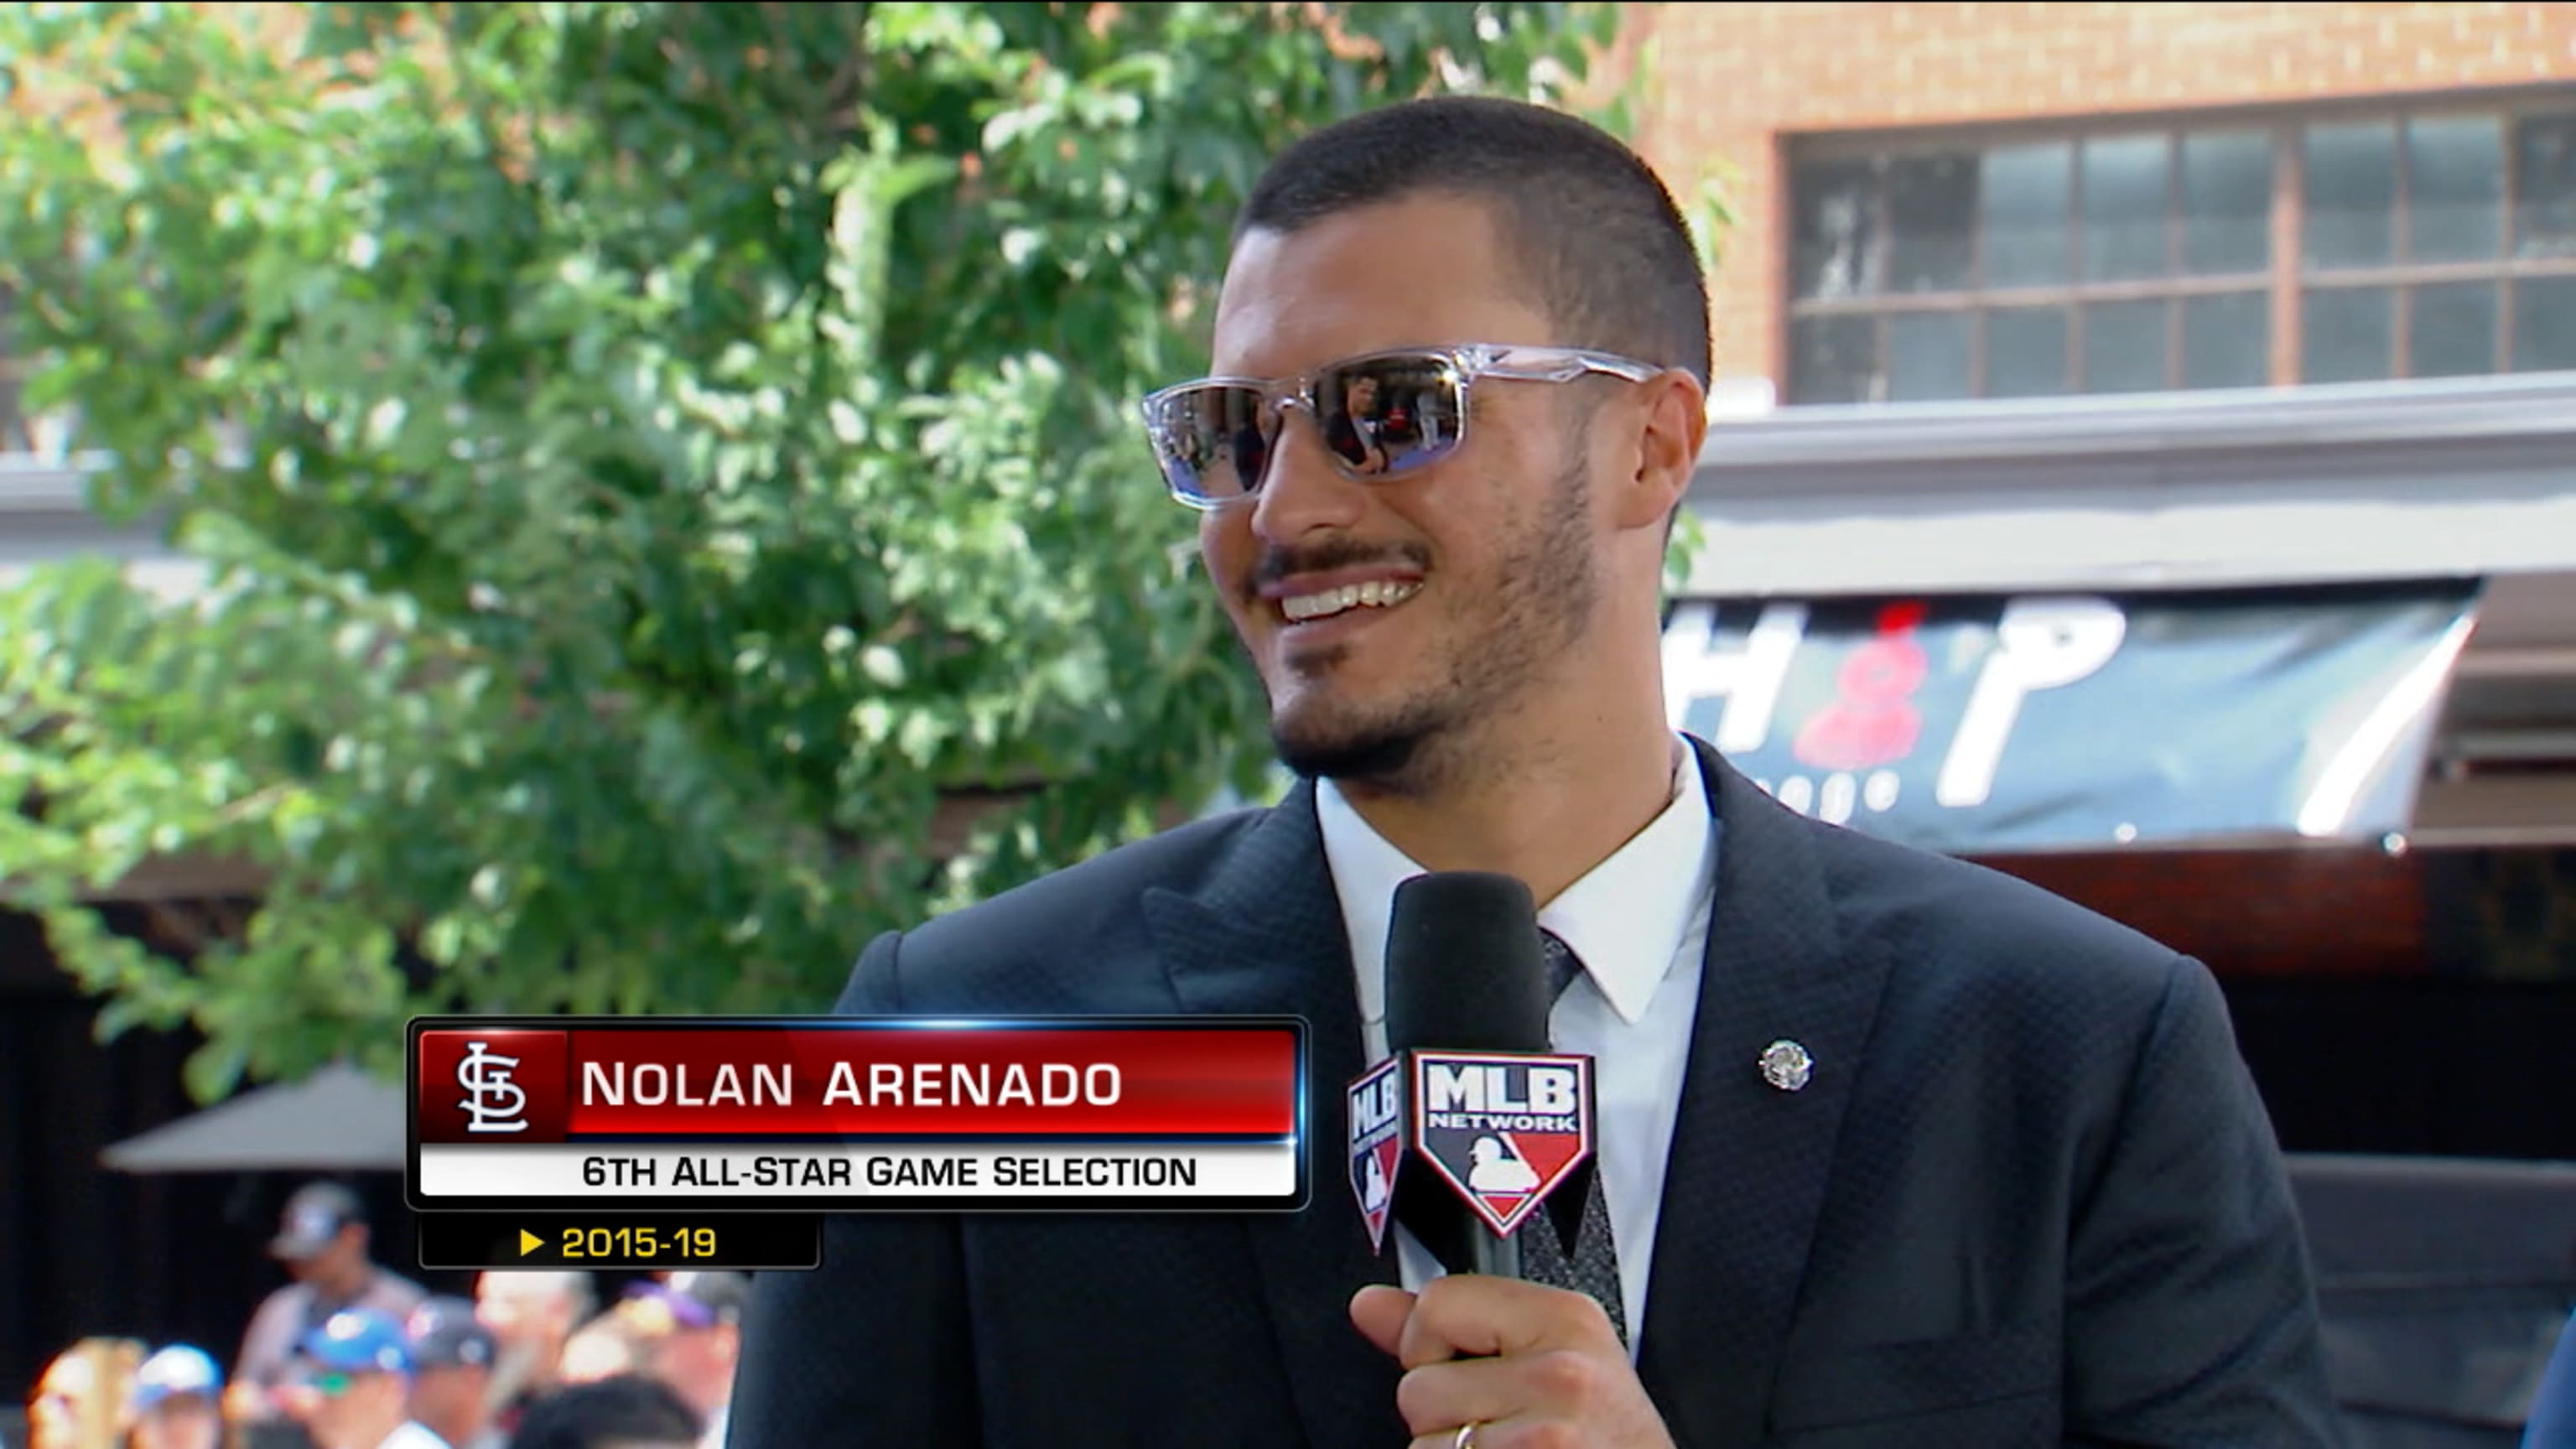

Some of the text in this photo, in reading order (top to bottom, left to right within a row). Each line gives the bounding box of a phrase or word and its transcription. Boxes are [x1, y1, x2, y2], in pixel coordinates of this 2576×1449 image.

[1353, 1071, 1398, 1135] MLB
[1427, 1064, 1576, 1114] MLB
[1428, 1113, 1577, 1132] NETWORK
